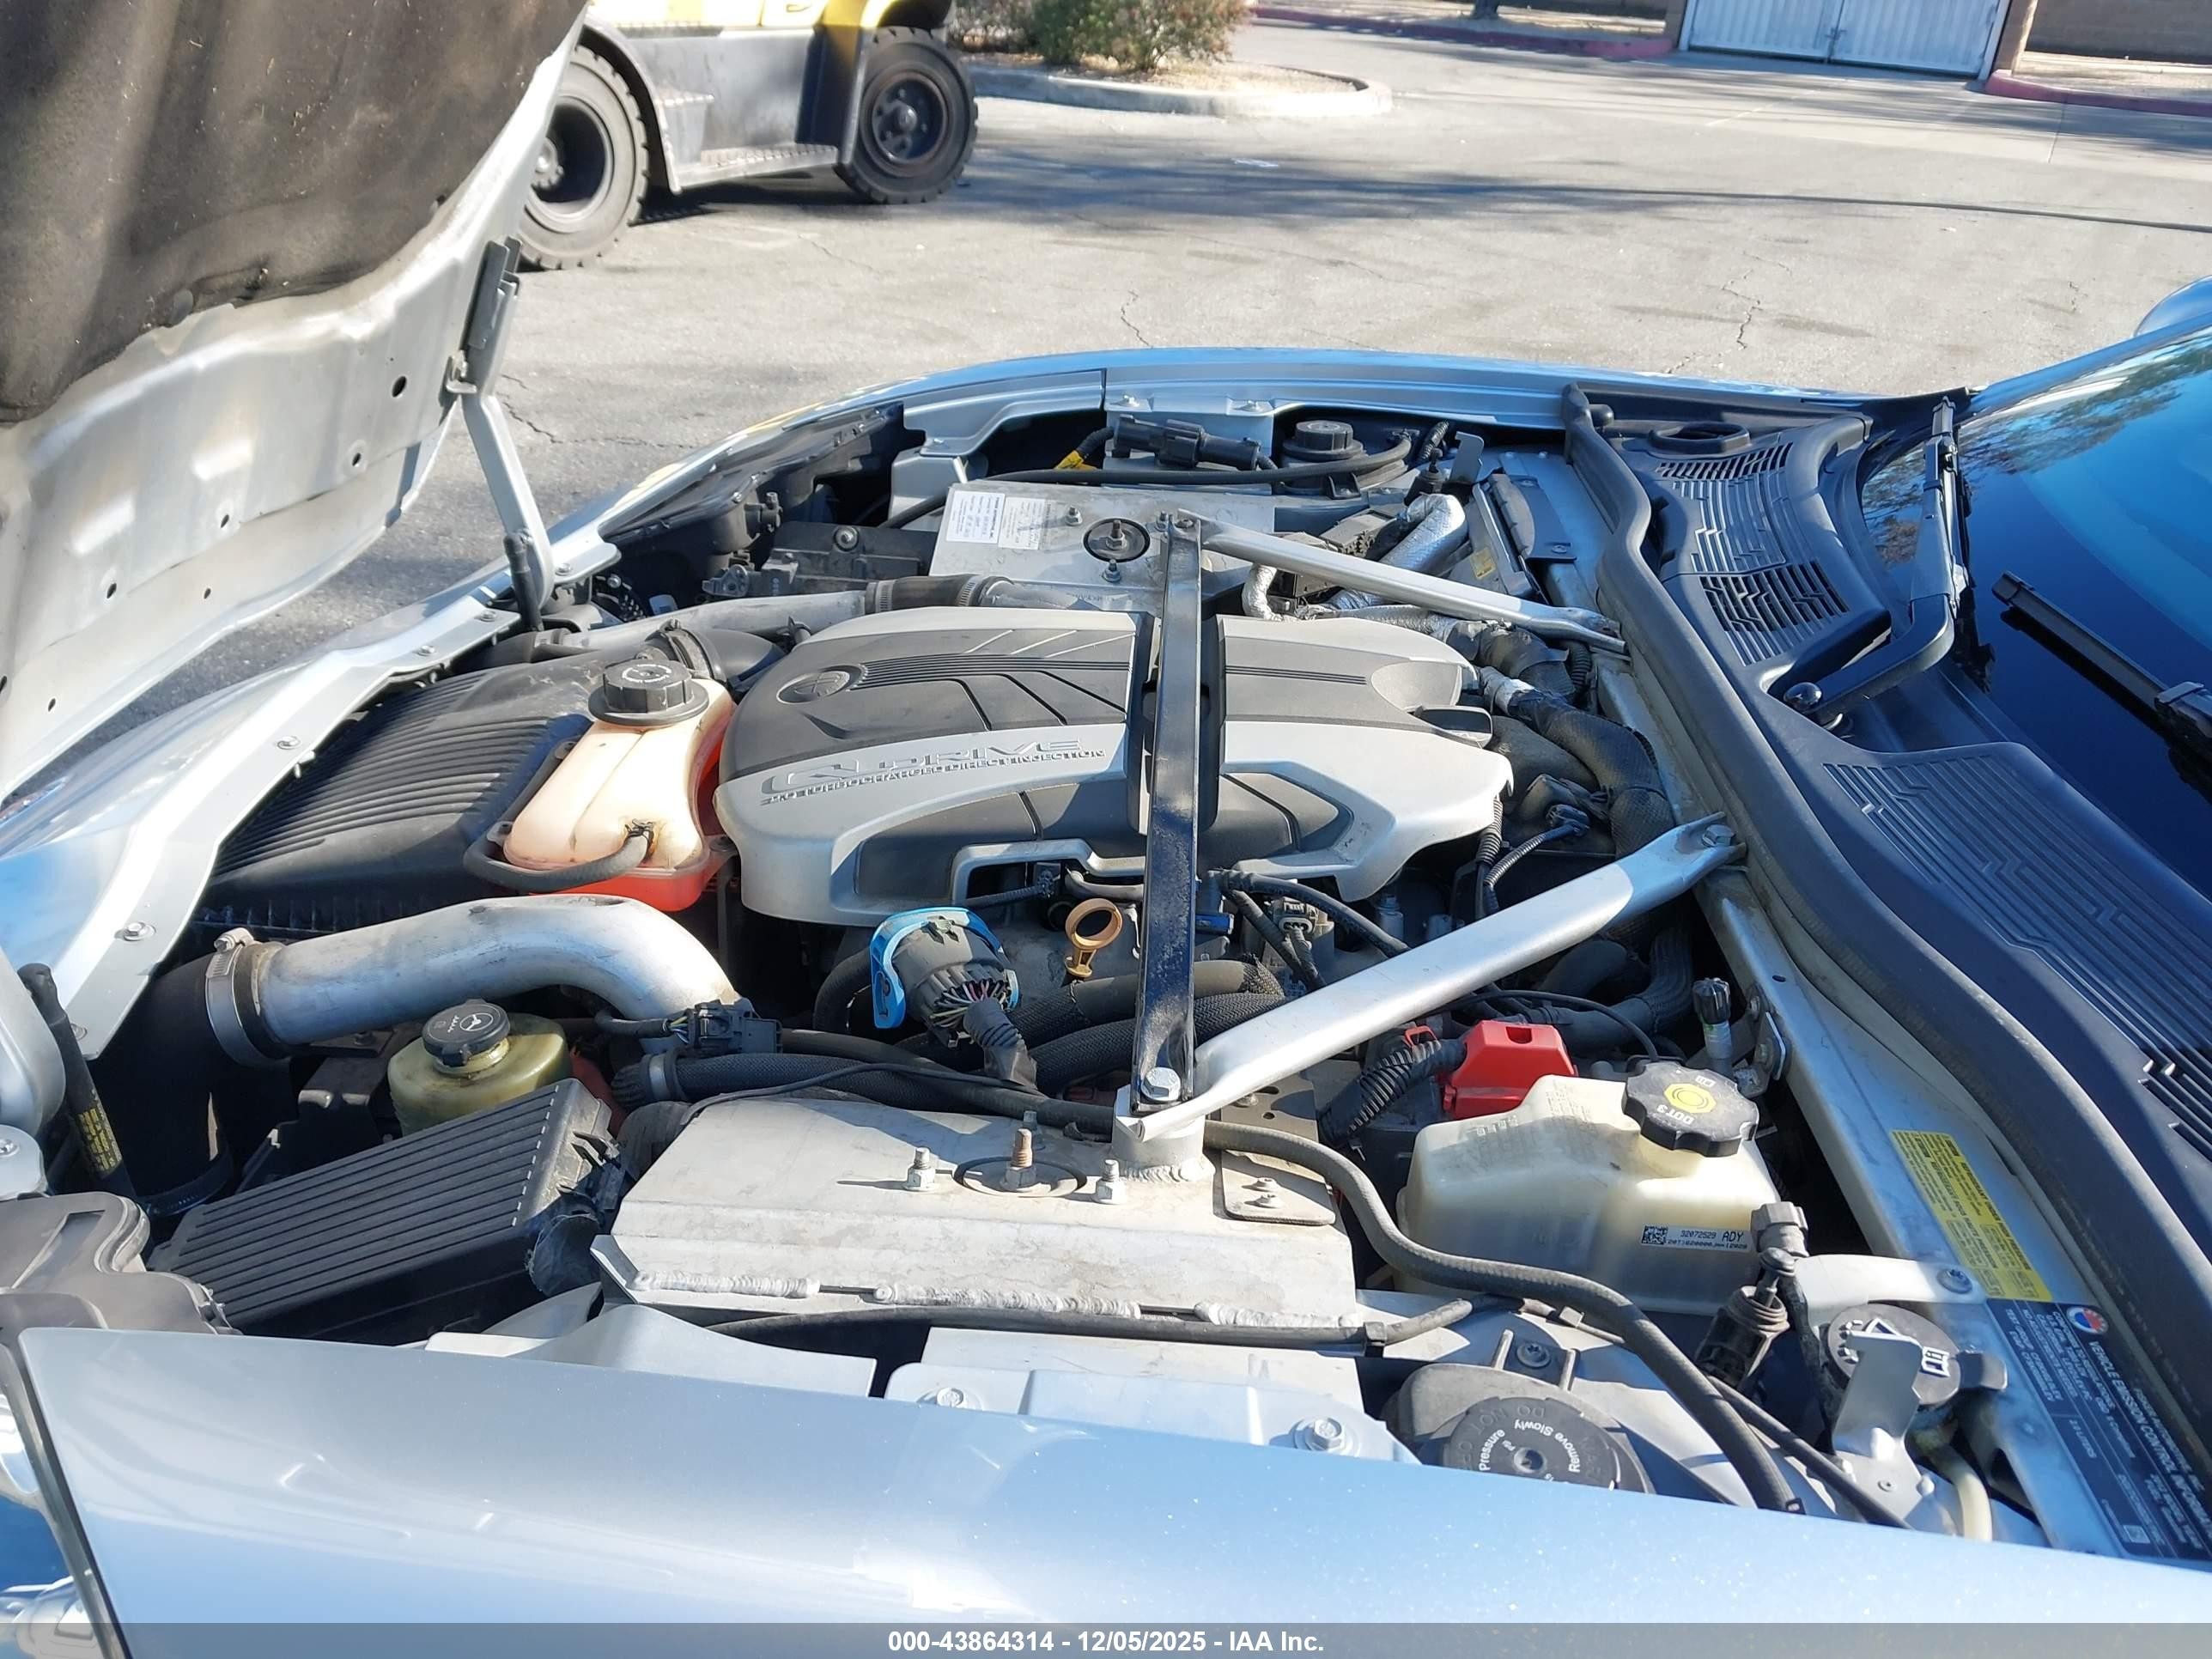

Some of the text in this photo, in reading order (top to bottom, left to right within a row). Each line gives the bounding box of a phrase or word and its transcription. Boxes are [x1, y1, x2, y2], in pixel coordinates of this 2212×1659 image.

[1657, 1103, 1695, 1126] DOT 3
[1722, 1231, 1744, 1243] ADY
[2089, 1341, 2121, 1380] VEHICLE
[2112, 1379, 2149, 1425] EMISSION
[2140, 1425, 2178, 1473] CONTROL
[1514, 1419, 1554, 1437] Slowly
[1478, 1429, 1506, 1472] Pressure
[1553, 1432, 1581, 1474] Remove
